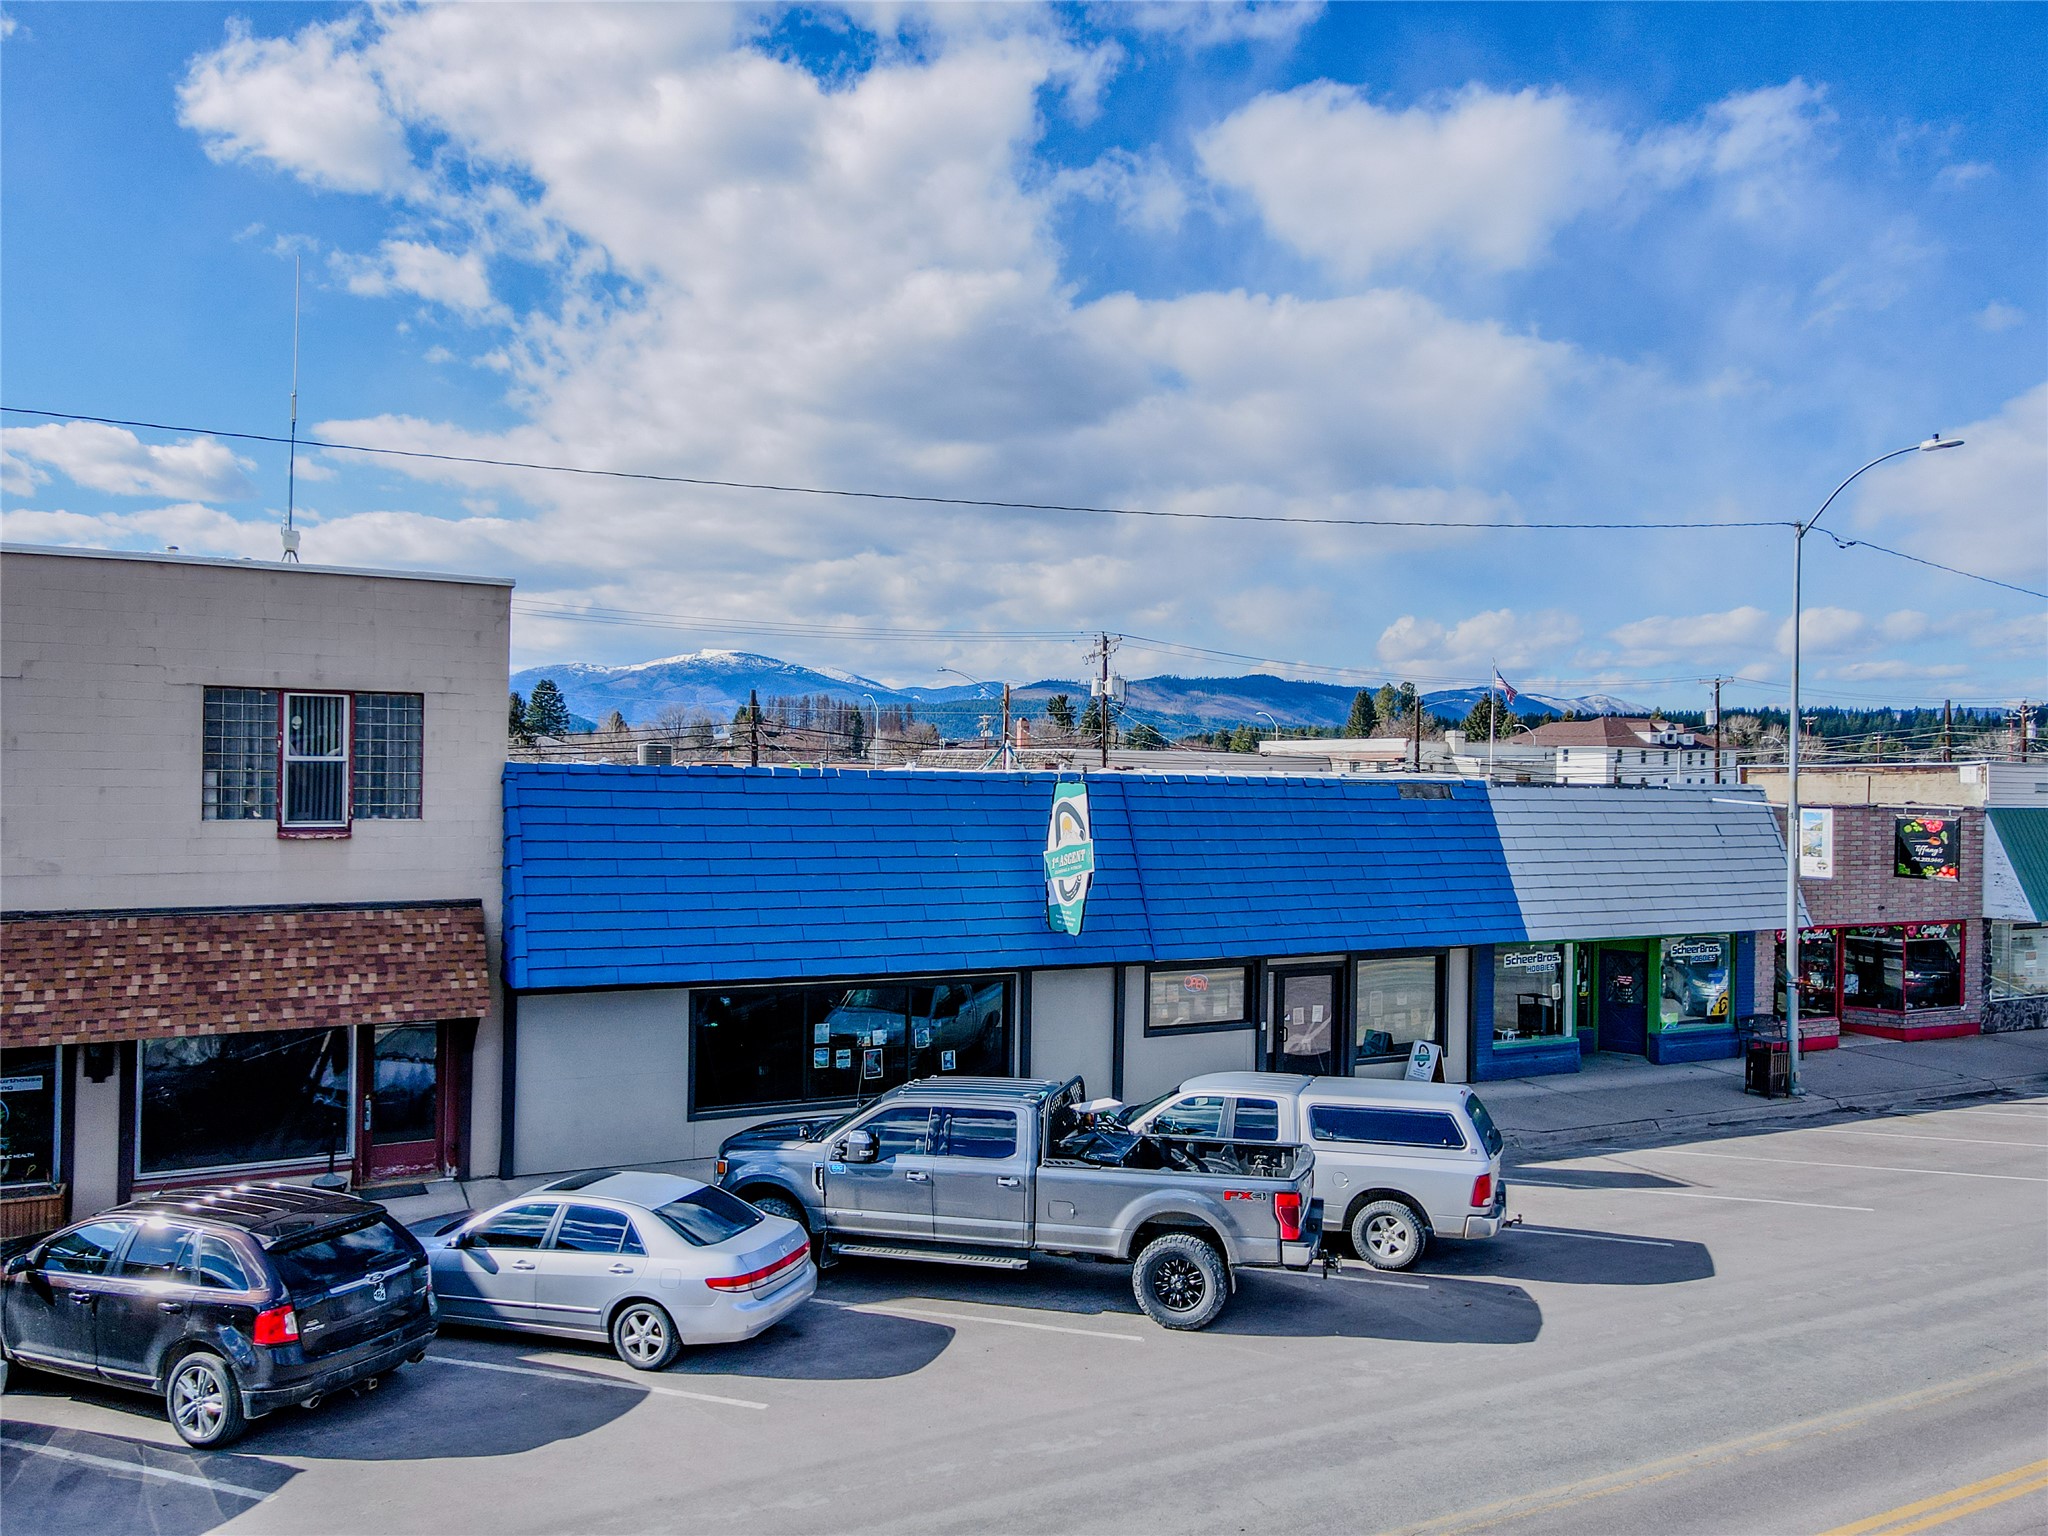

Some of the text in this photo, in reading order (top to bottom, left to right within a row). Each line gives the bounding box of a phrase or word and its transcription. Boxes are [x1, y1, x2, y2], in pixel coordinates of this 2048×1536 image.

[1060, 849, 1086, 867] ASCENT
[1672, 943, 1720, 955] ScheerBros.
[1505, 952, 1560, 966] ScheerBros.
[1527, 963, 1555, 973] HOBBIES
[1184, 976, 1208, 991] OPEN
[1223, 1190, 1267, 1201] FX4
